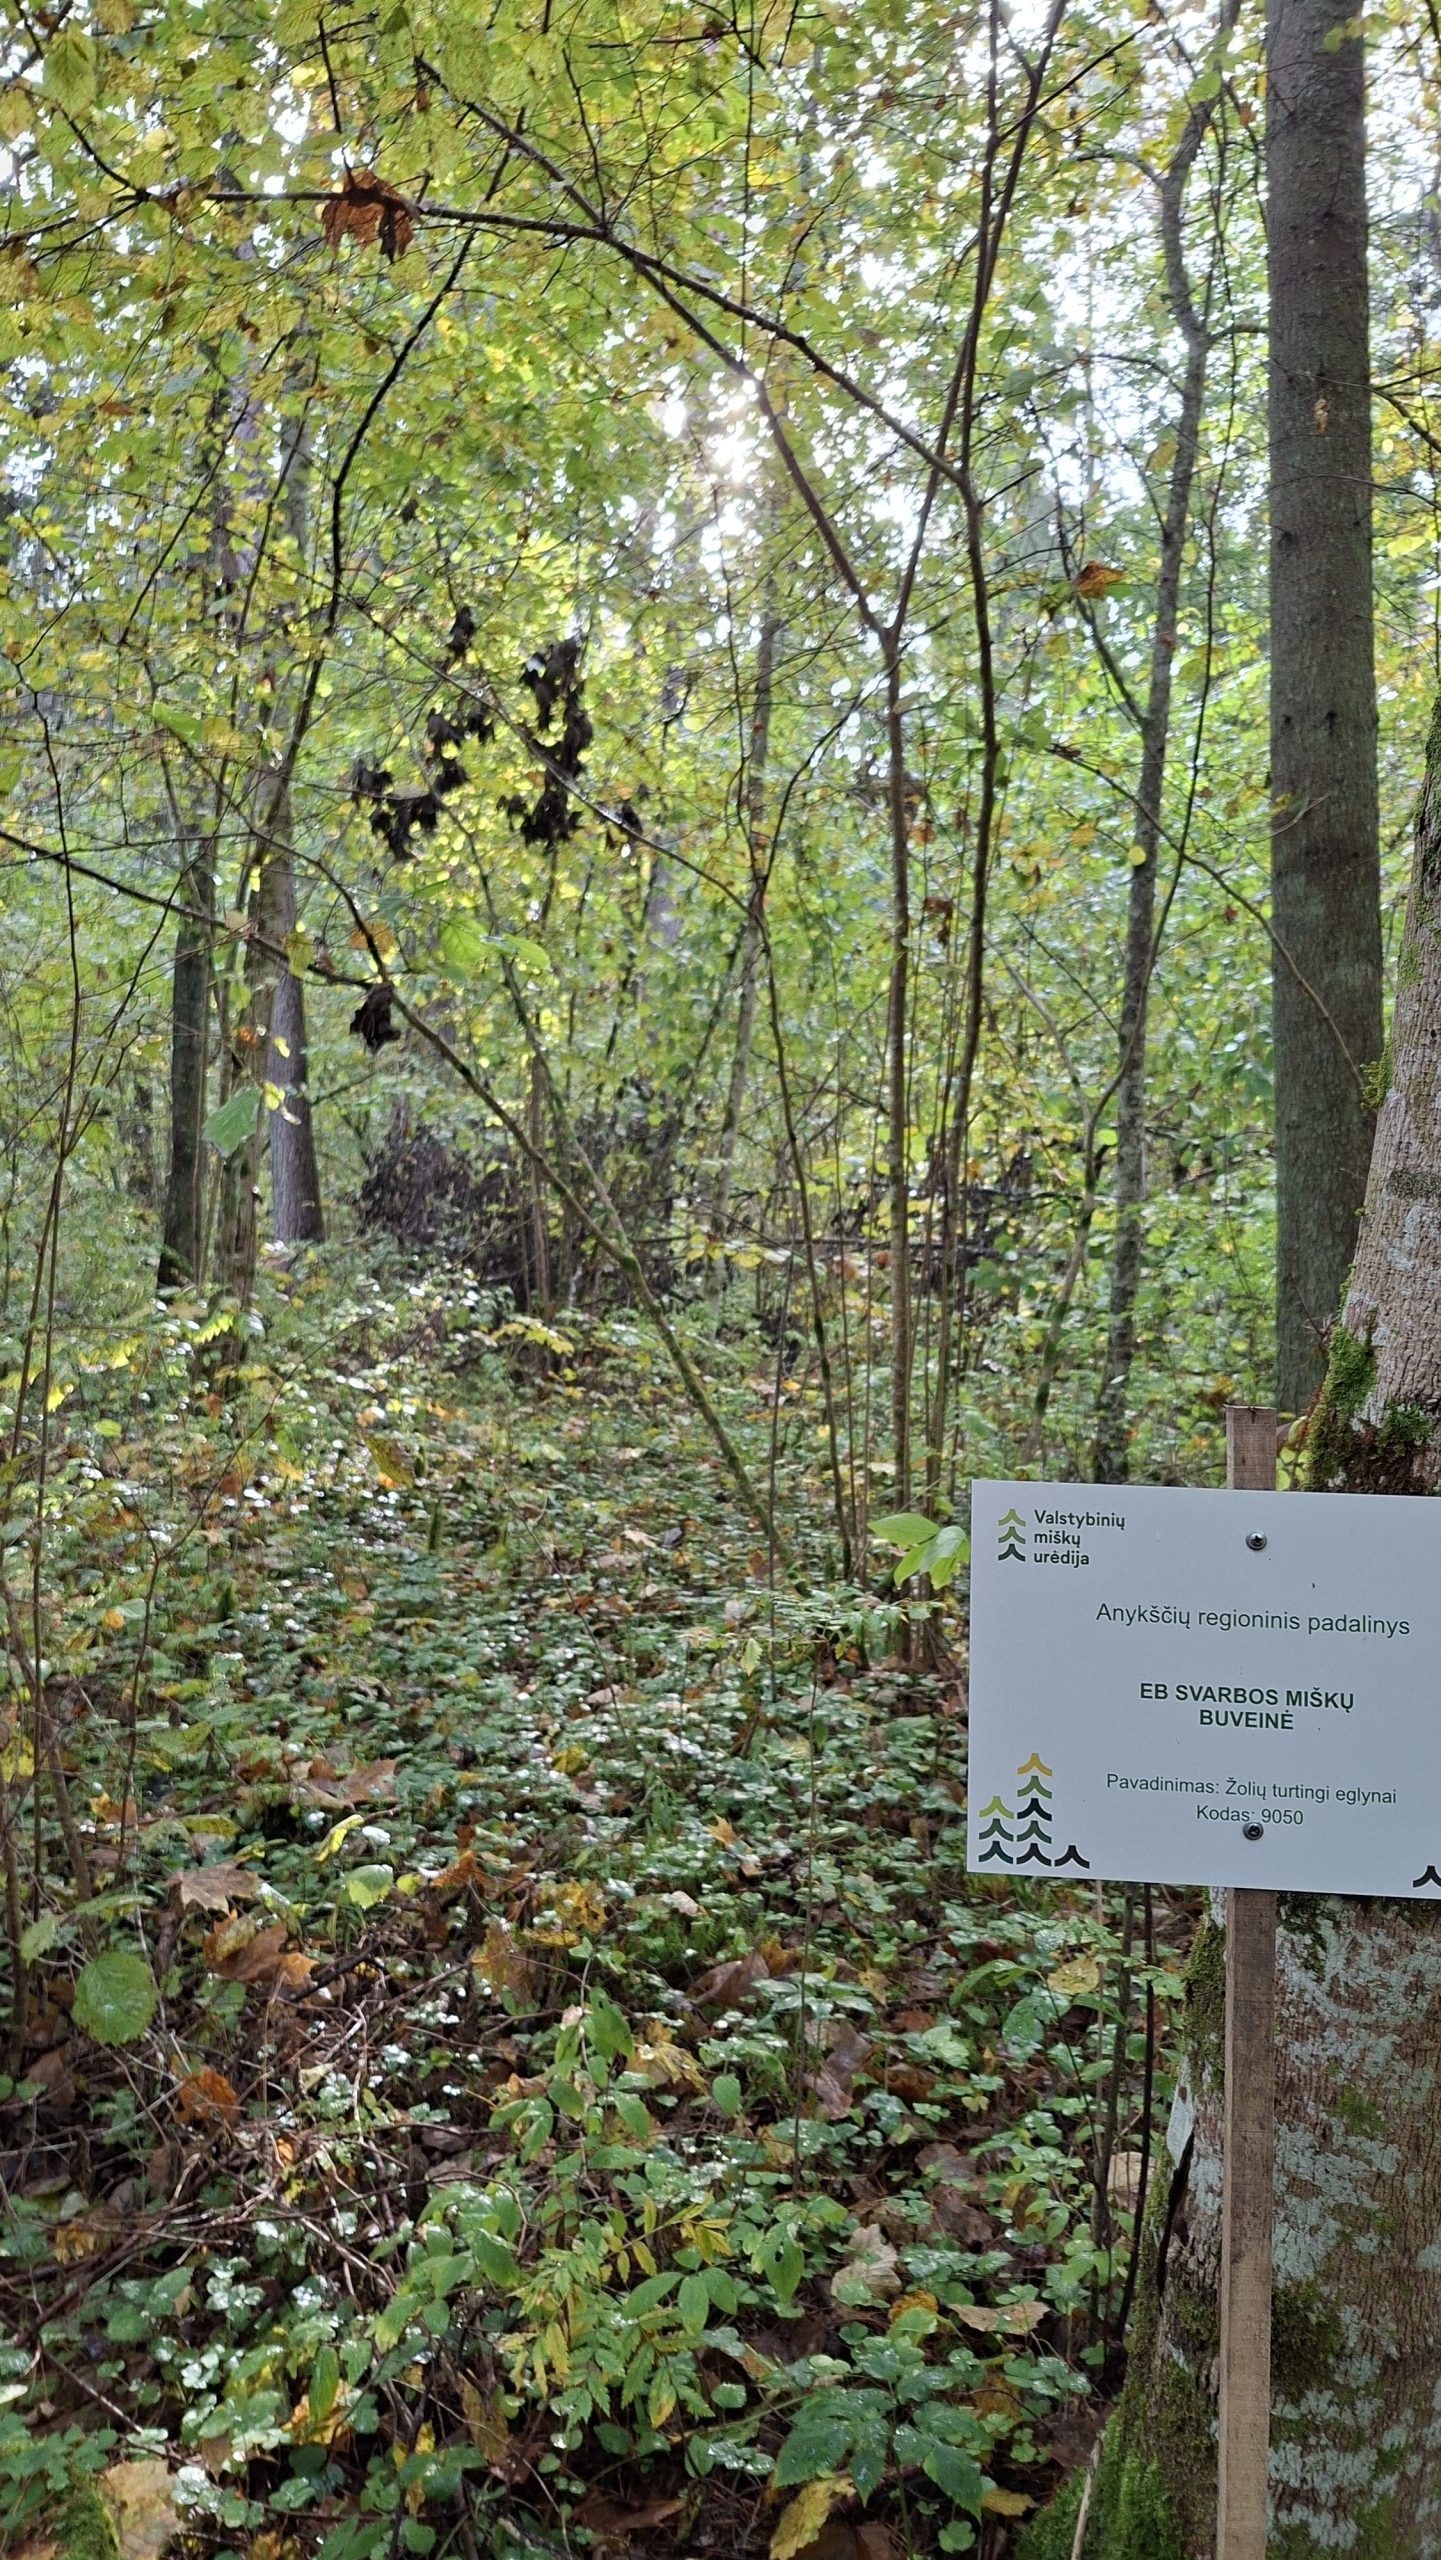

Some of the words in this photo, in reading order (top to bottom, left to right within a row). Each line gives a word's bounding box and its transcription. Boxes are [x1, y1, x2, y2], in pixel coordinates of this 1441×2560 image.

[1034, 1510, 1125, 1531] Valstybinių
[1034, 1530, 1081, 1548] miškų
[1034, 1550, 1089, 1568] urėdija
[1096, 1603, 1190, 1629] Anykščių
[1199, 1609, 1300, 1631] regioninis
[1309, 1614, 1409, 1638] padalinys
[1141, 1683, 1168, 1699] EB
[1176, 1685, 1278, 1705] SVARBOS
[1285, 1687, 1353, 1713] MIŠKŲ
[1200, 1710, 1293, 1729] BUVEINĖ
[1108, 1774, 1219, 1794] Pavadinimas:
[1226, 1777, 1266, 1800] Žolių
[1272, 1784, 1329, 1803] turtingi
[1336, 1787, 1396, 1805] eglynai
[1197, 1805, 1254, 1821] Kodas:
[1261, 1809, 1303, 1826] 9050
